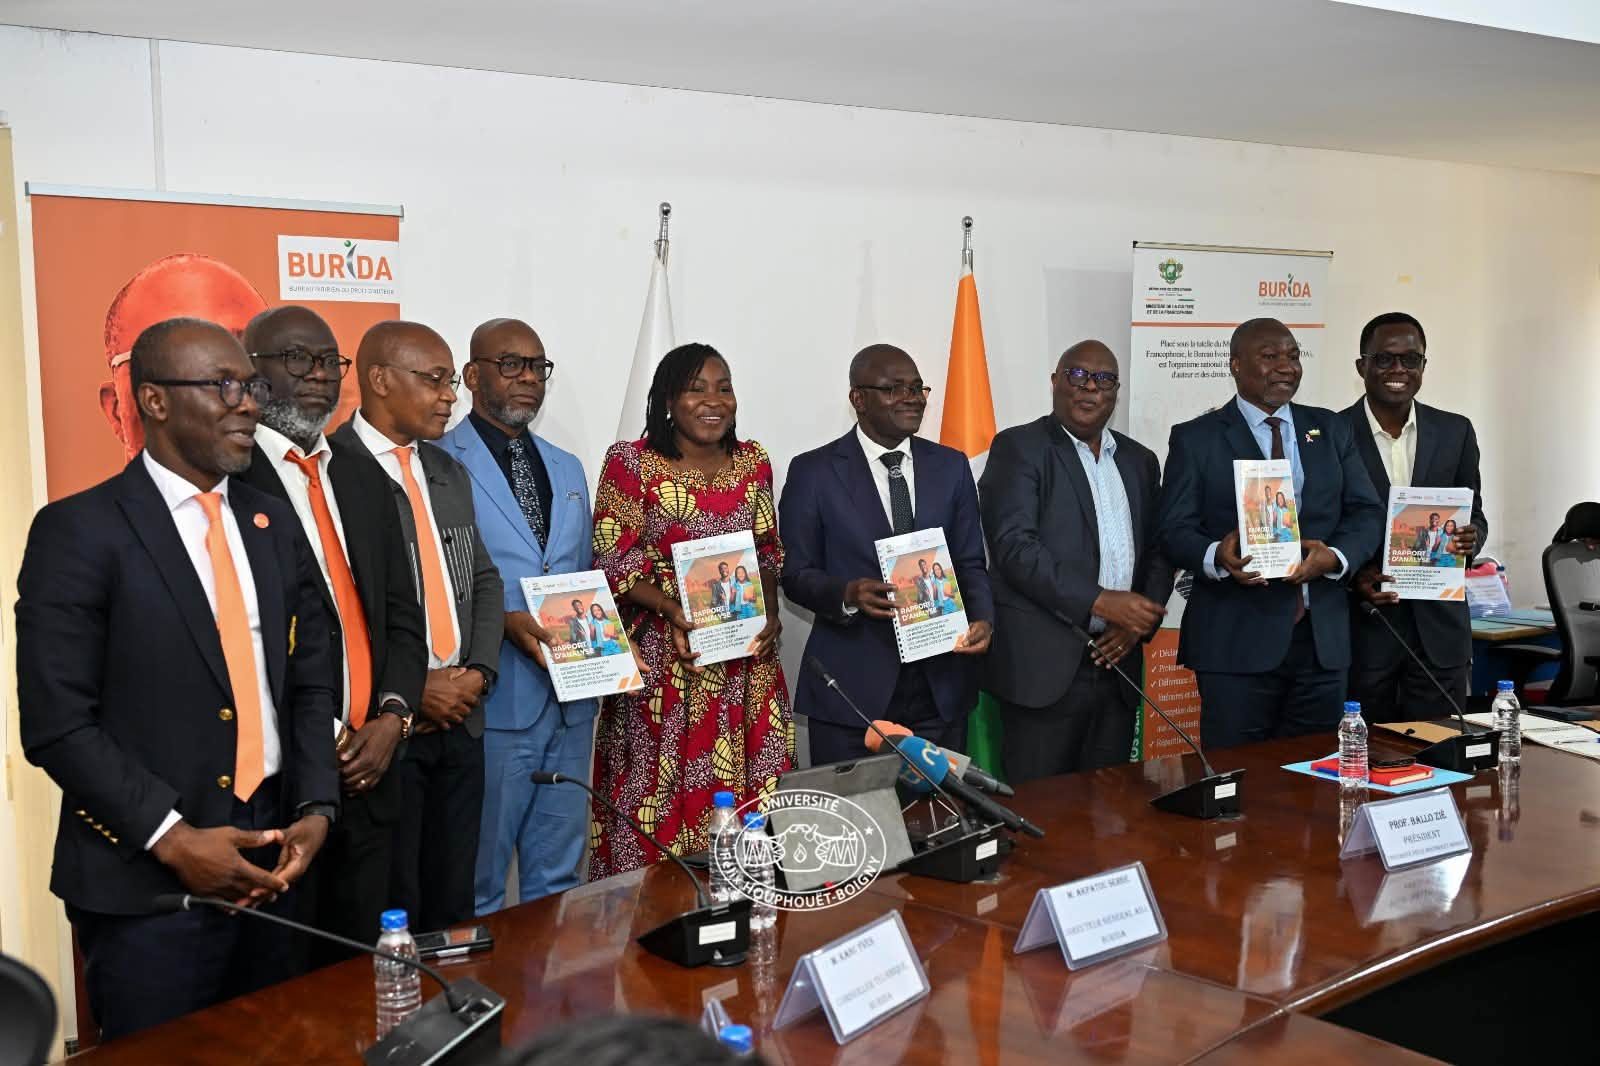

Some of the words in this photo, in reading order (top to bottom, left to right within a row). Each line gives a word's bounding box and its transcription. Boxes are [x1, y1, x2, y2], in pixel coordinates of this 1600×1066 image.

[287, 241, 393, 281] BURIDA
[1258, 274, 1312, 298] BURIDA
[1388, 817, 1411, 830] PROF.
[1411, 813, 1434, 826] BALLO
